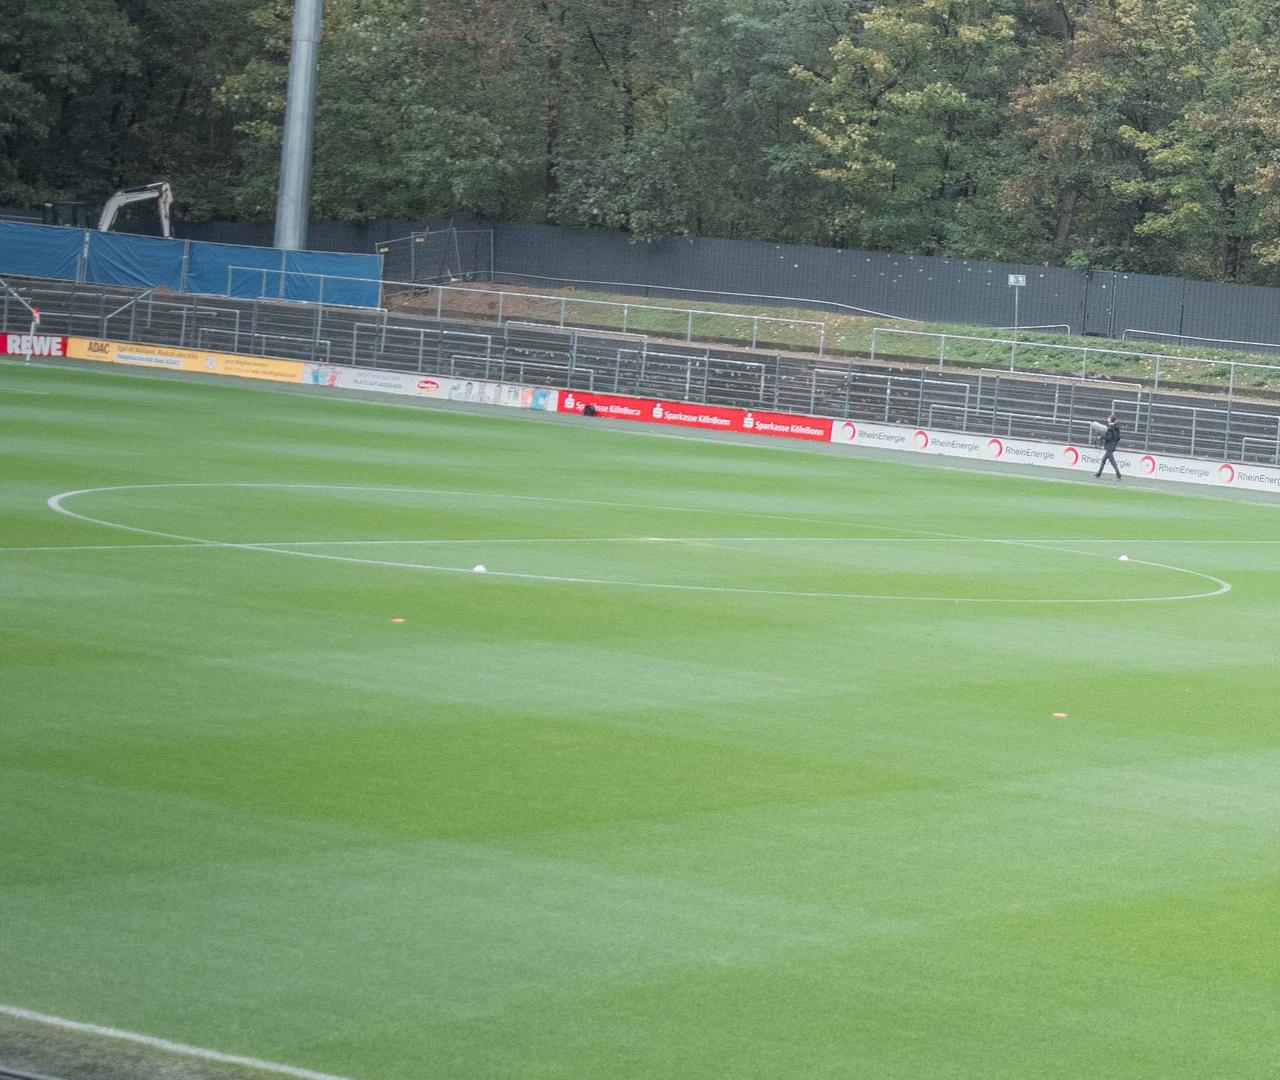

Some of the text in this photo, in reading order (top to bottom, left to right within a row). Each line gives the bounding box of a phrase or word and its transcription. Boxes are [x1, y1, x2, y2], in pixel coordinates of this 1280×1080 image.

[6, 334, 63, 356] REWE
[88, 342, 111, 354] ADAC
[664, 411, 731, 426] Sparkasse KölnBonn
[755, 420, 824, 436] Sparkasse KölnBonn
[858, 430, 906, 443] RheinEnergie
[930, 438, 980, 452] RheinEnergie
[1005, 446, 1055, 460] RheinEnergie
[1158, 463, 1210, 478] RheinEnergie
